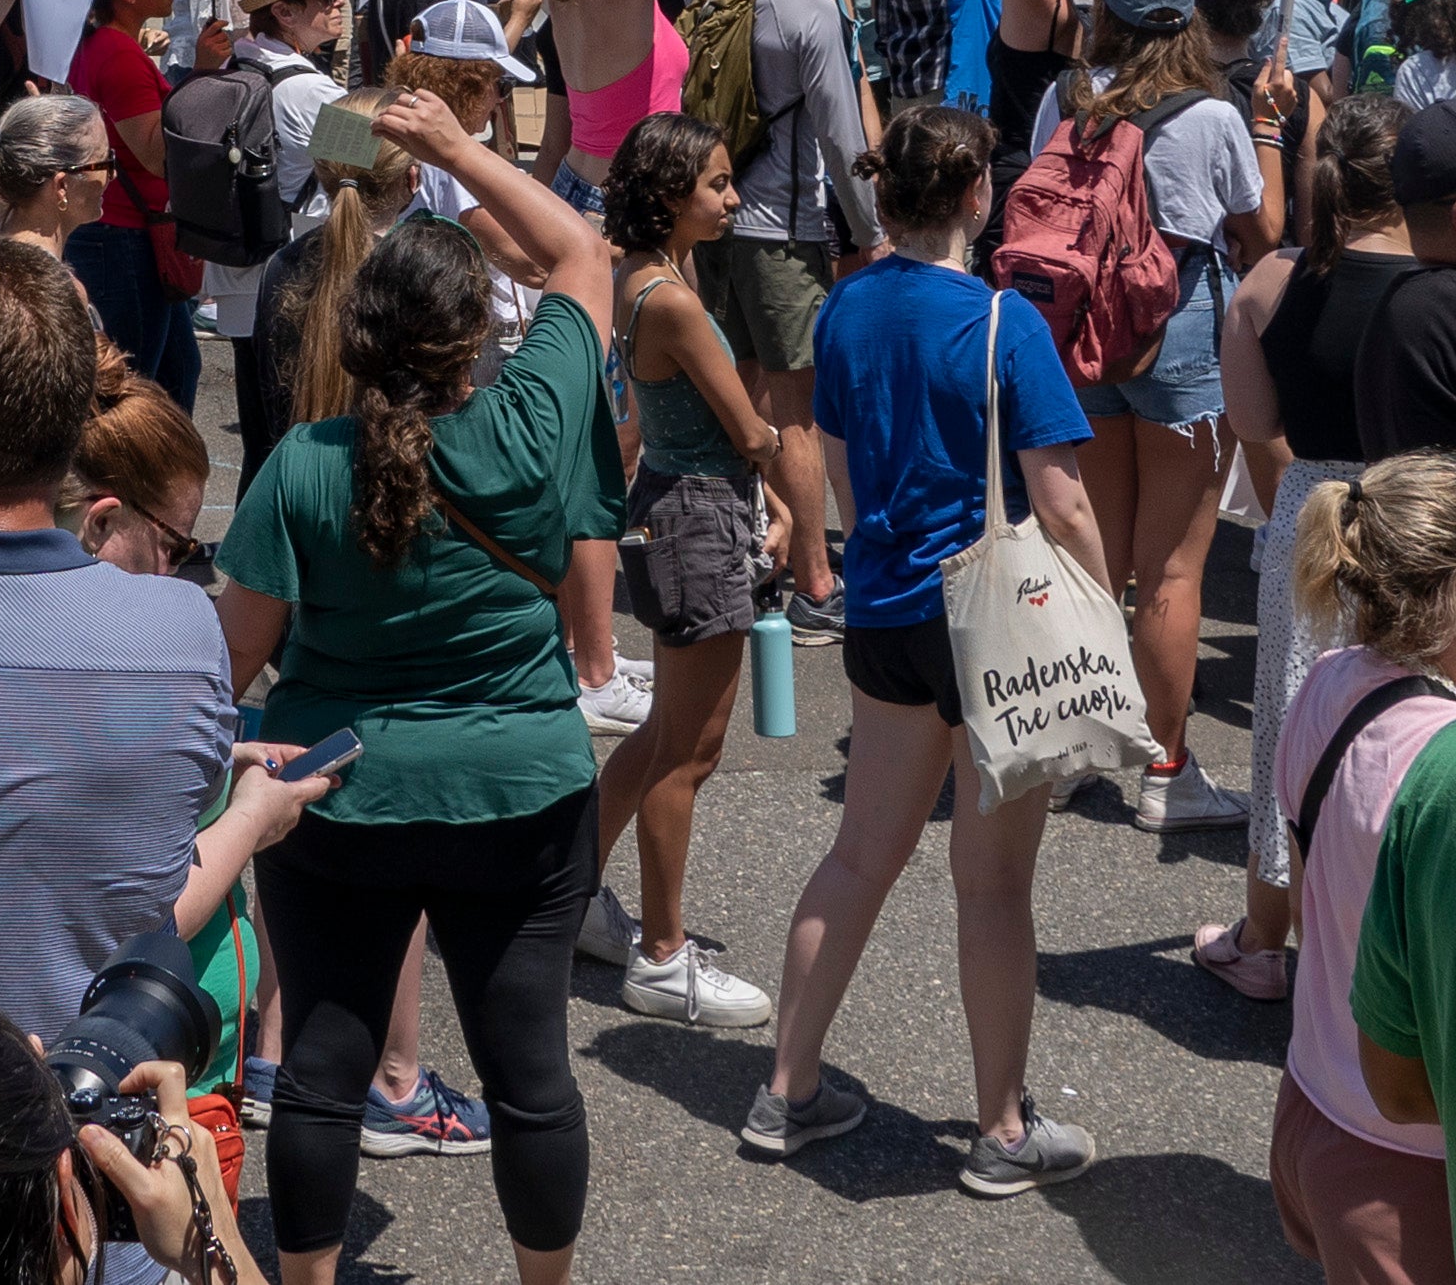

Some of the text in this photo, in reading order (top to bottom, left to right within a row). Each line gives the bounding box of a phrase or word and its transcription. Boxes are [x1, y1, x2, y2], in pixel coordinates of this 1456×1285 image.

[982, 645, 1121, 707] Radenska.
[994, 684, 1132, 746] Tre cuori.
